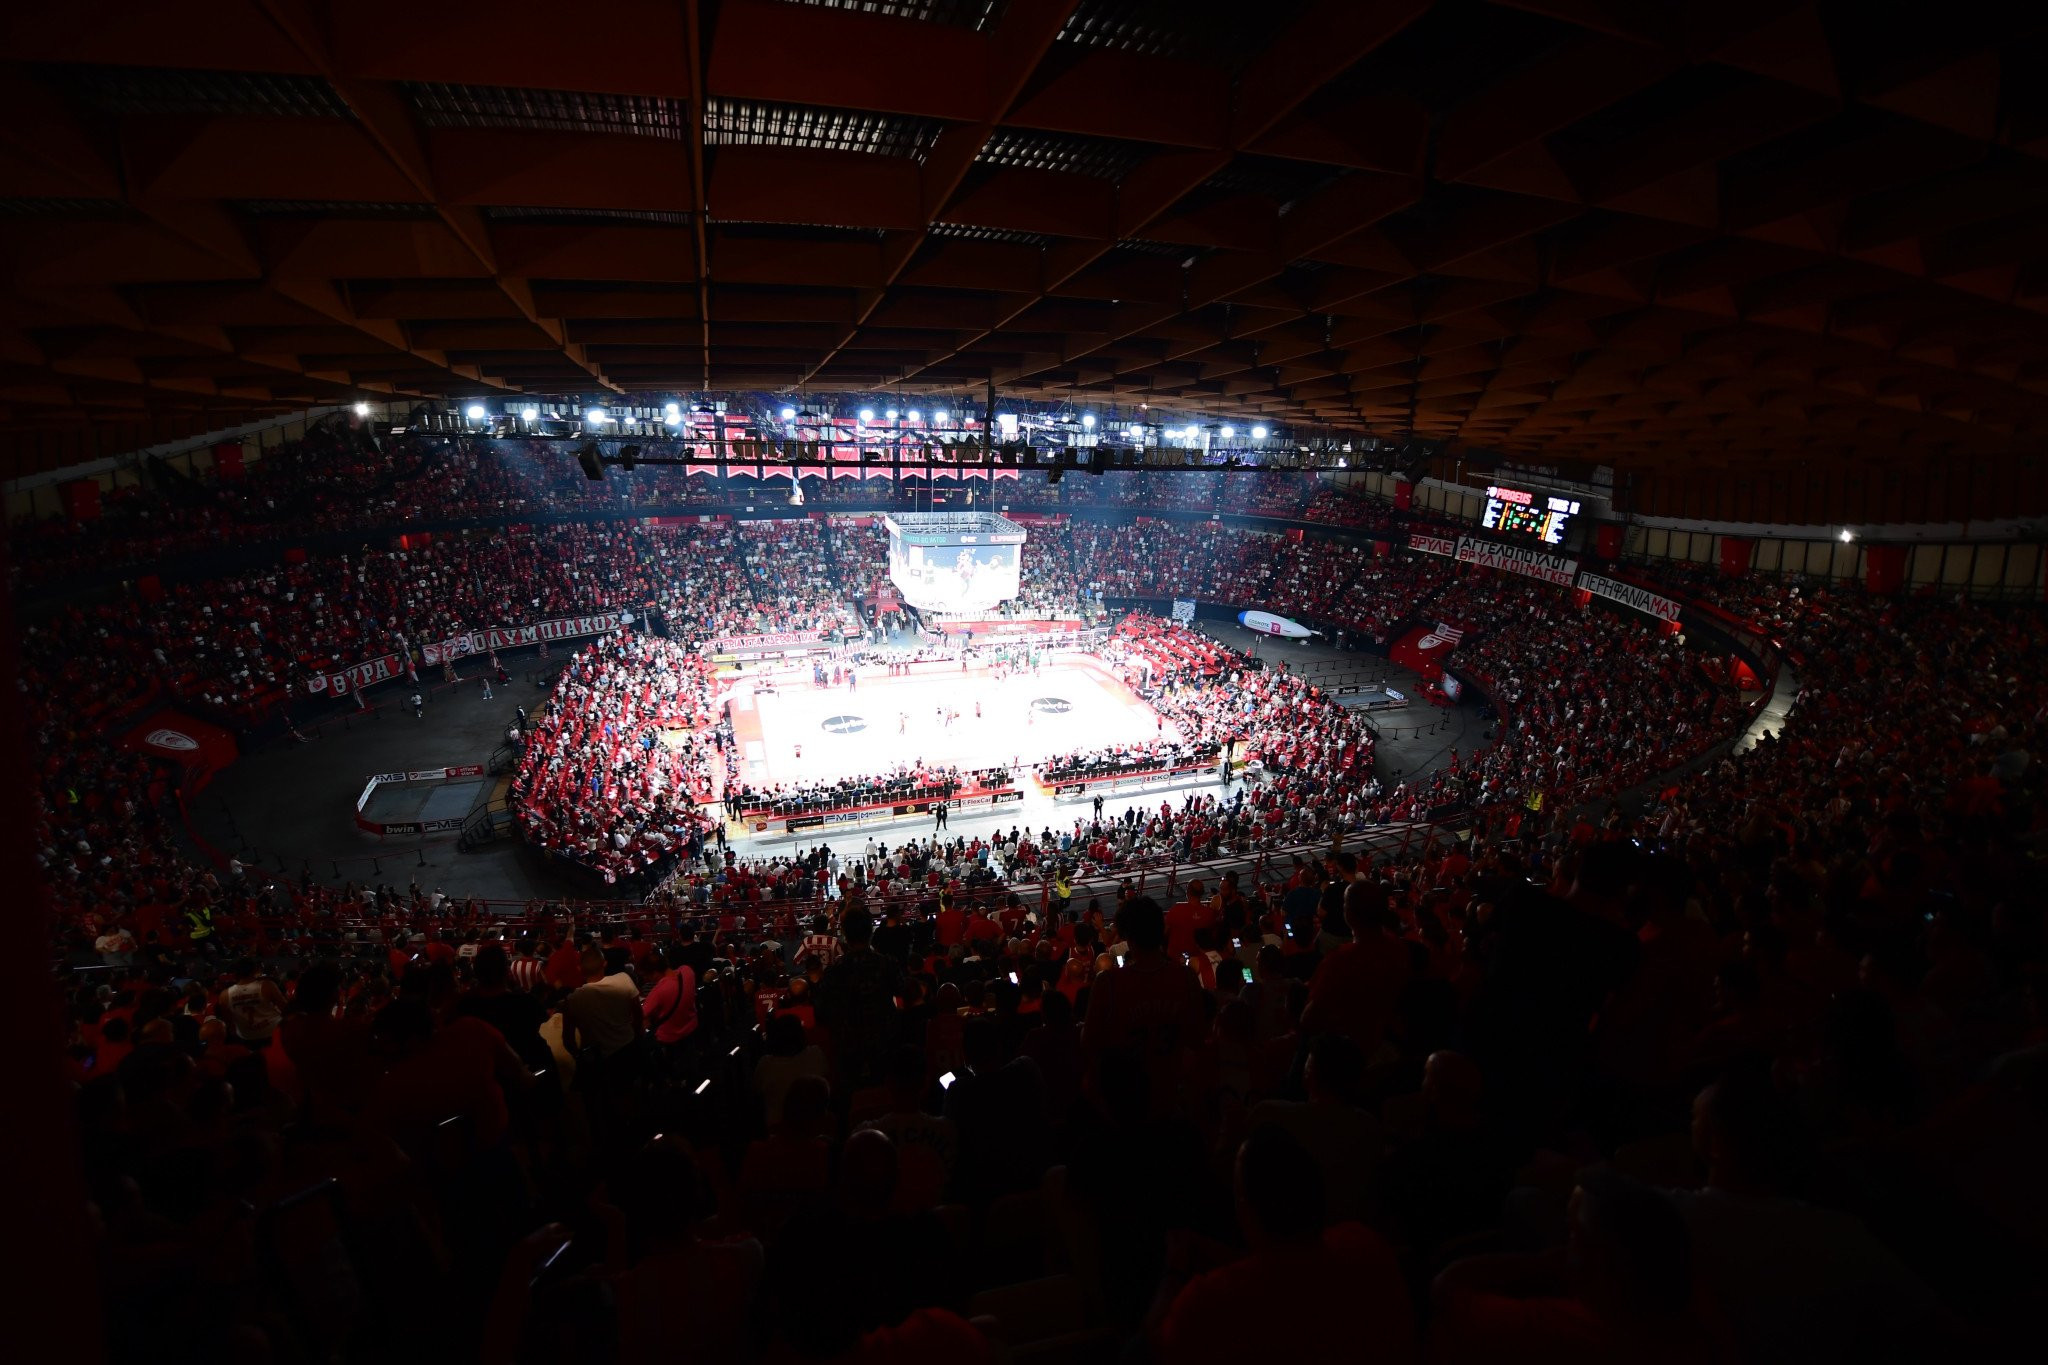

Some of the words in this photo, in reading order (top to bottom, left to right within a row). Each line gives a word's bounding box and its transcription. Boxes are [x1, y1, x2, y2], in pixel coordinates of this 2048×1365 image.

[1497, 487, 1532, 505] PIRAEUS
[1409, 536, 1453, 555] ΘΡΥΛΕ
[1460, 537, 1568, 571] ΑΓΓΕΛΟΠΟΥΛΟΙ
[473, 613, 620, 651] ΟΛΥΜΠΙΑΚΟΣ
[332, 659, 390, 694] ΘΥΡΑ
[967, 798, 992, 806] FlexCar
[996, 792, 1019, 802] bwin
[825, 812, 858, 823] FMS
[386, 825, 415, 834] bwin
[423, 819, 463, 832] FMS
